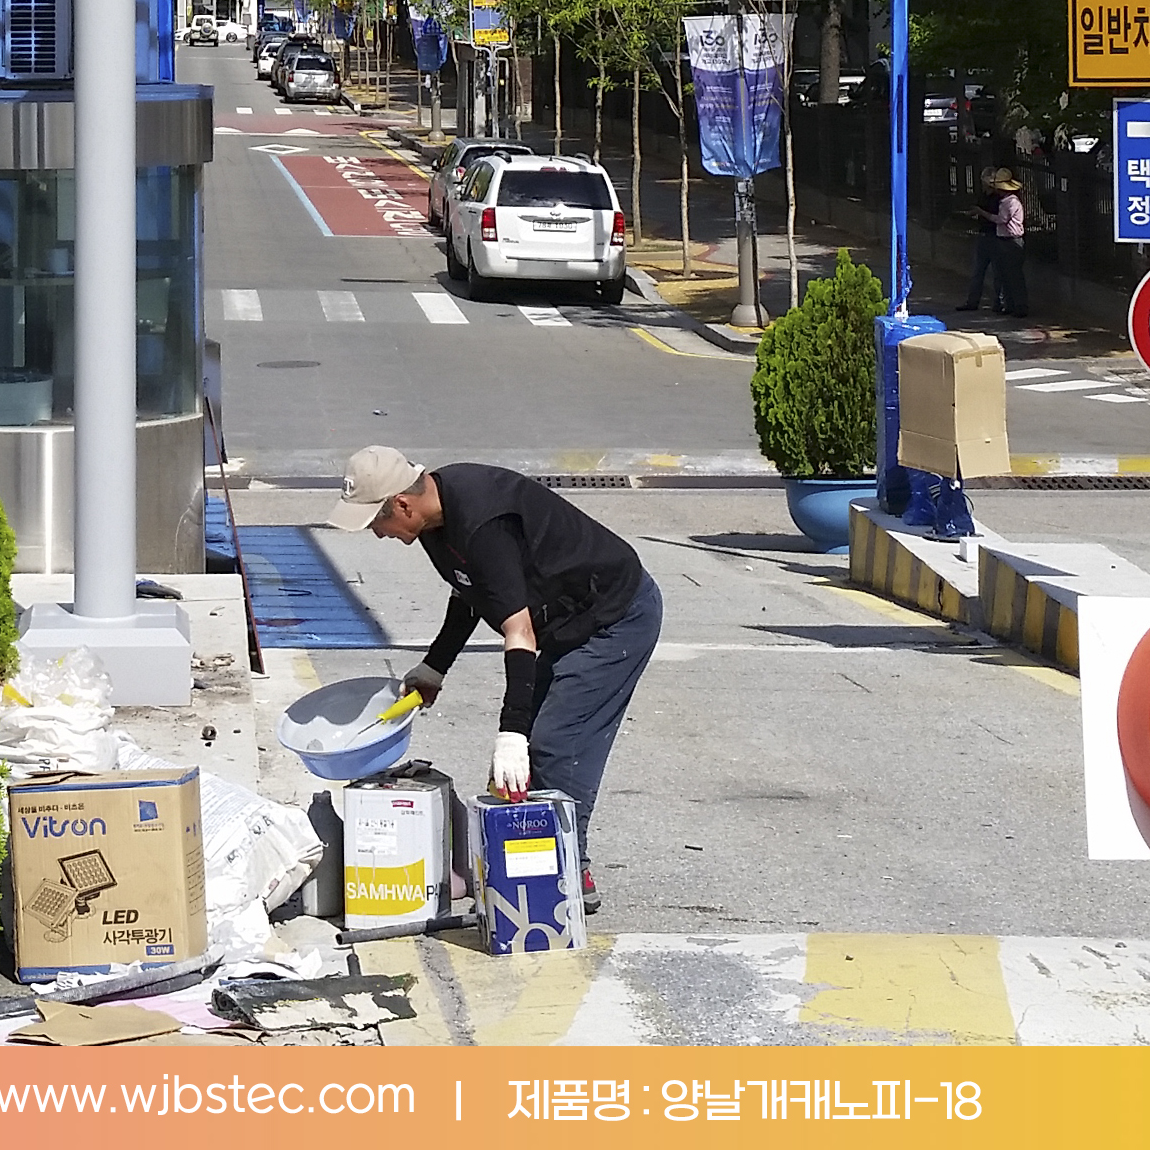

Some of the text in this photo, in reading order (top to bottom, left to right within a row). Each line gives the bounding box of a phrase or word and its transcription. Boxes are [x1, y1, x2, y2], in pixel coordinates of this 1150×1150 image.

[346, 881, 425, 903] SAMHWA
[102, 909, 140, 926] LED
[103, 927, 173, 946] 사각투광기
[150, 946, 171, 955] 30W
